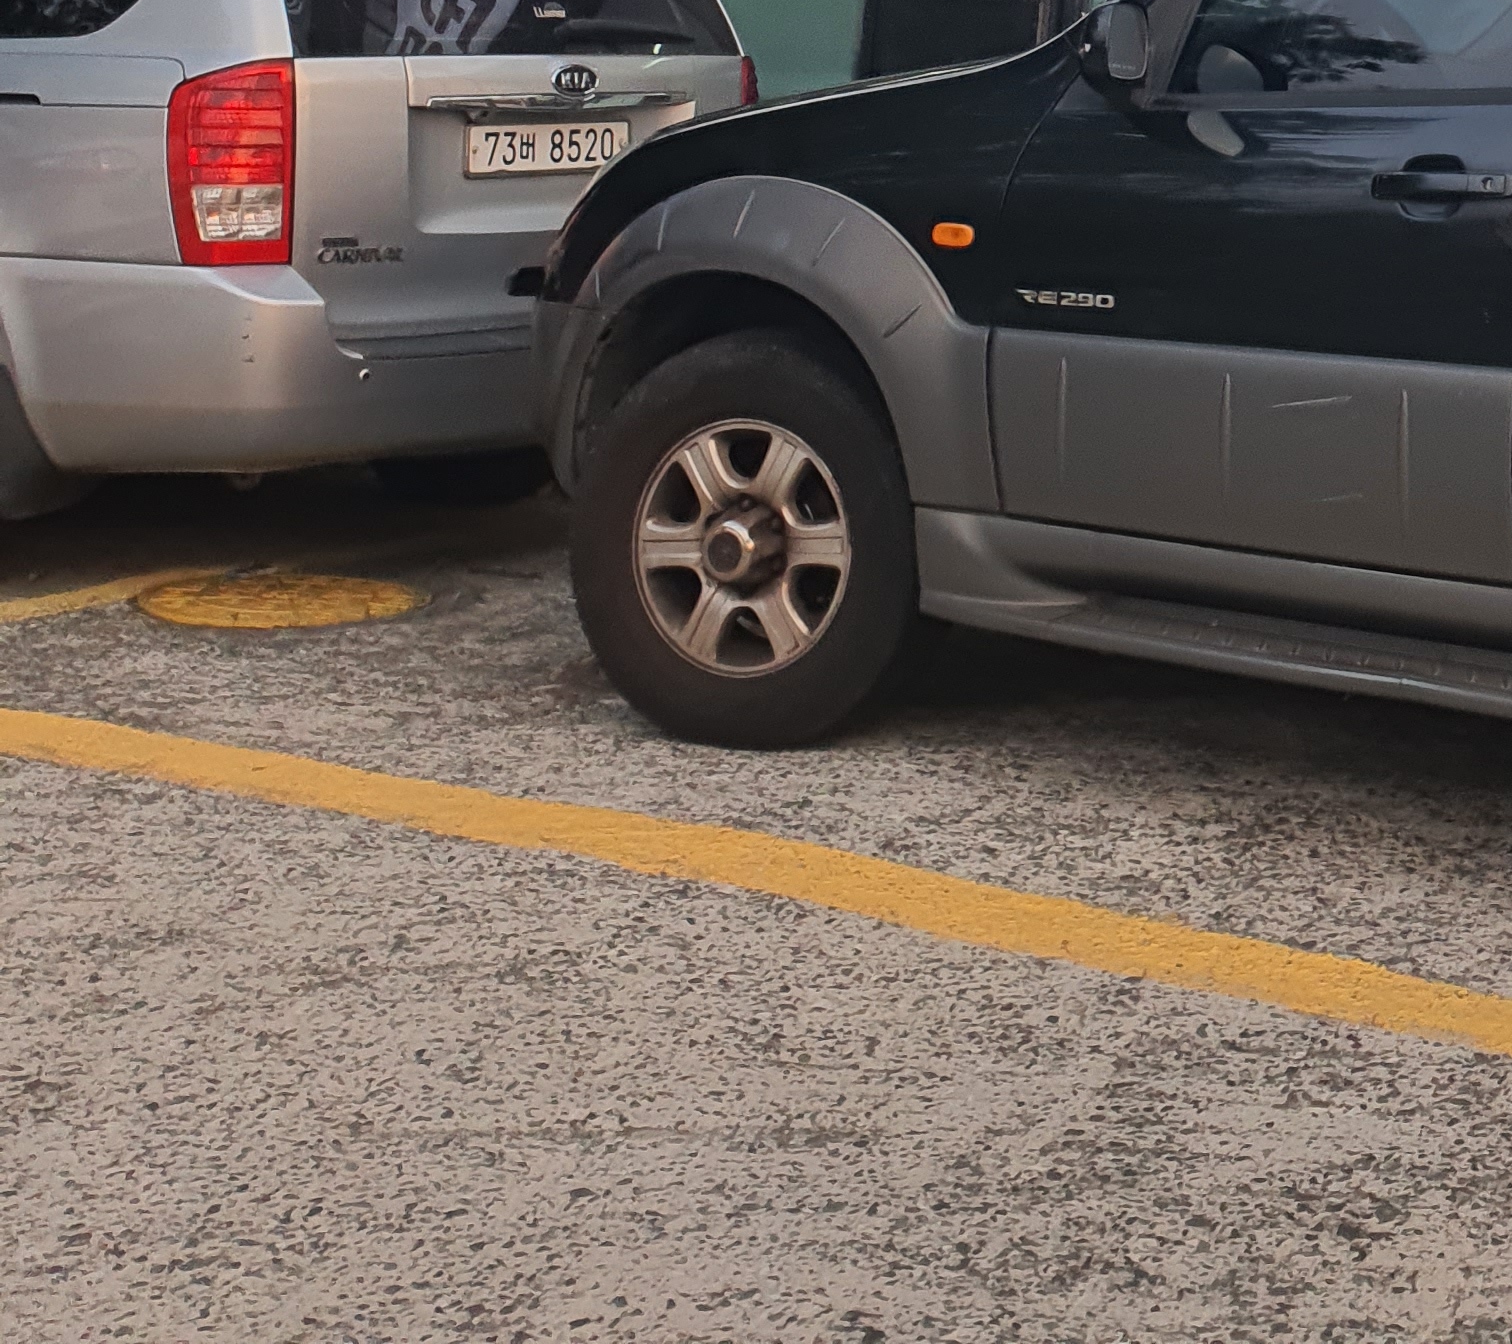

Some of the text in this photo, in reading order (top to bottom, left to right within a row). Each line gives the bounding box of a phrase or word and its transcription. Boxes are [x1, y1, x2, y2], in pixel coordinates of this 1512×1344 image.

[560, 71, 593, 89] KIA
[484, 127, 615, 167] 73버 8520
